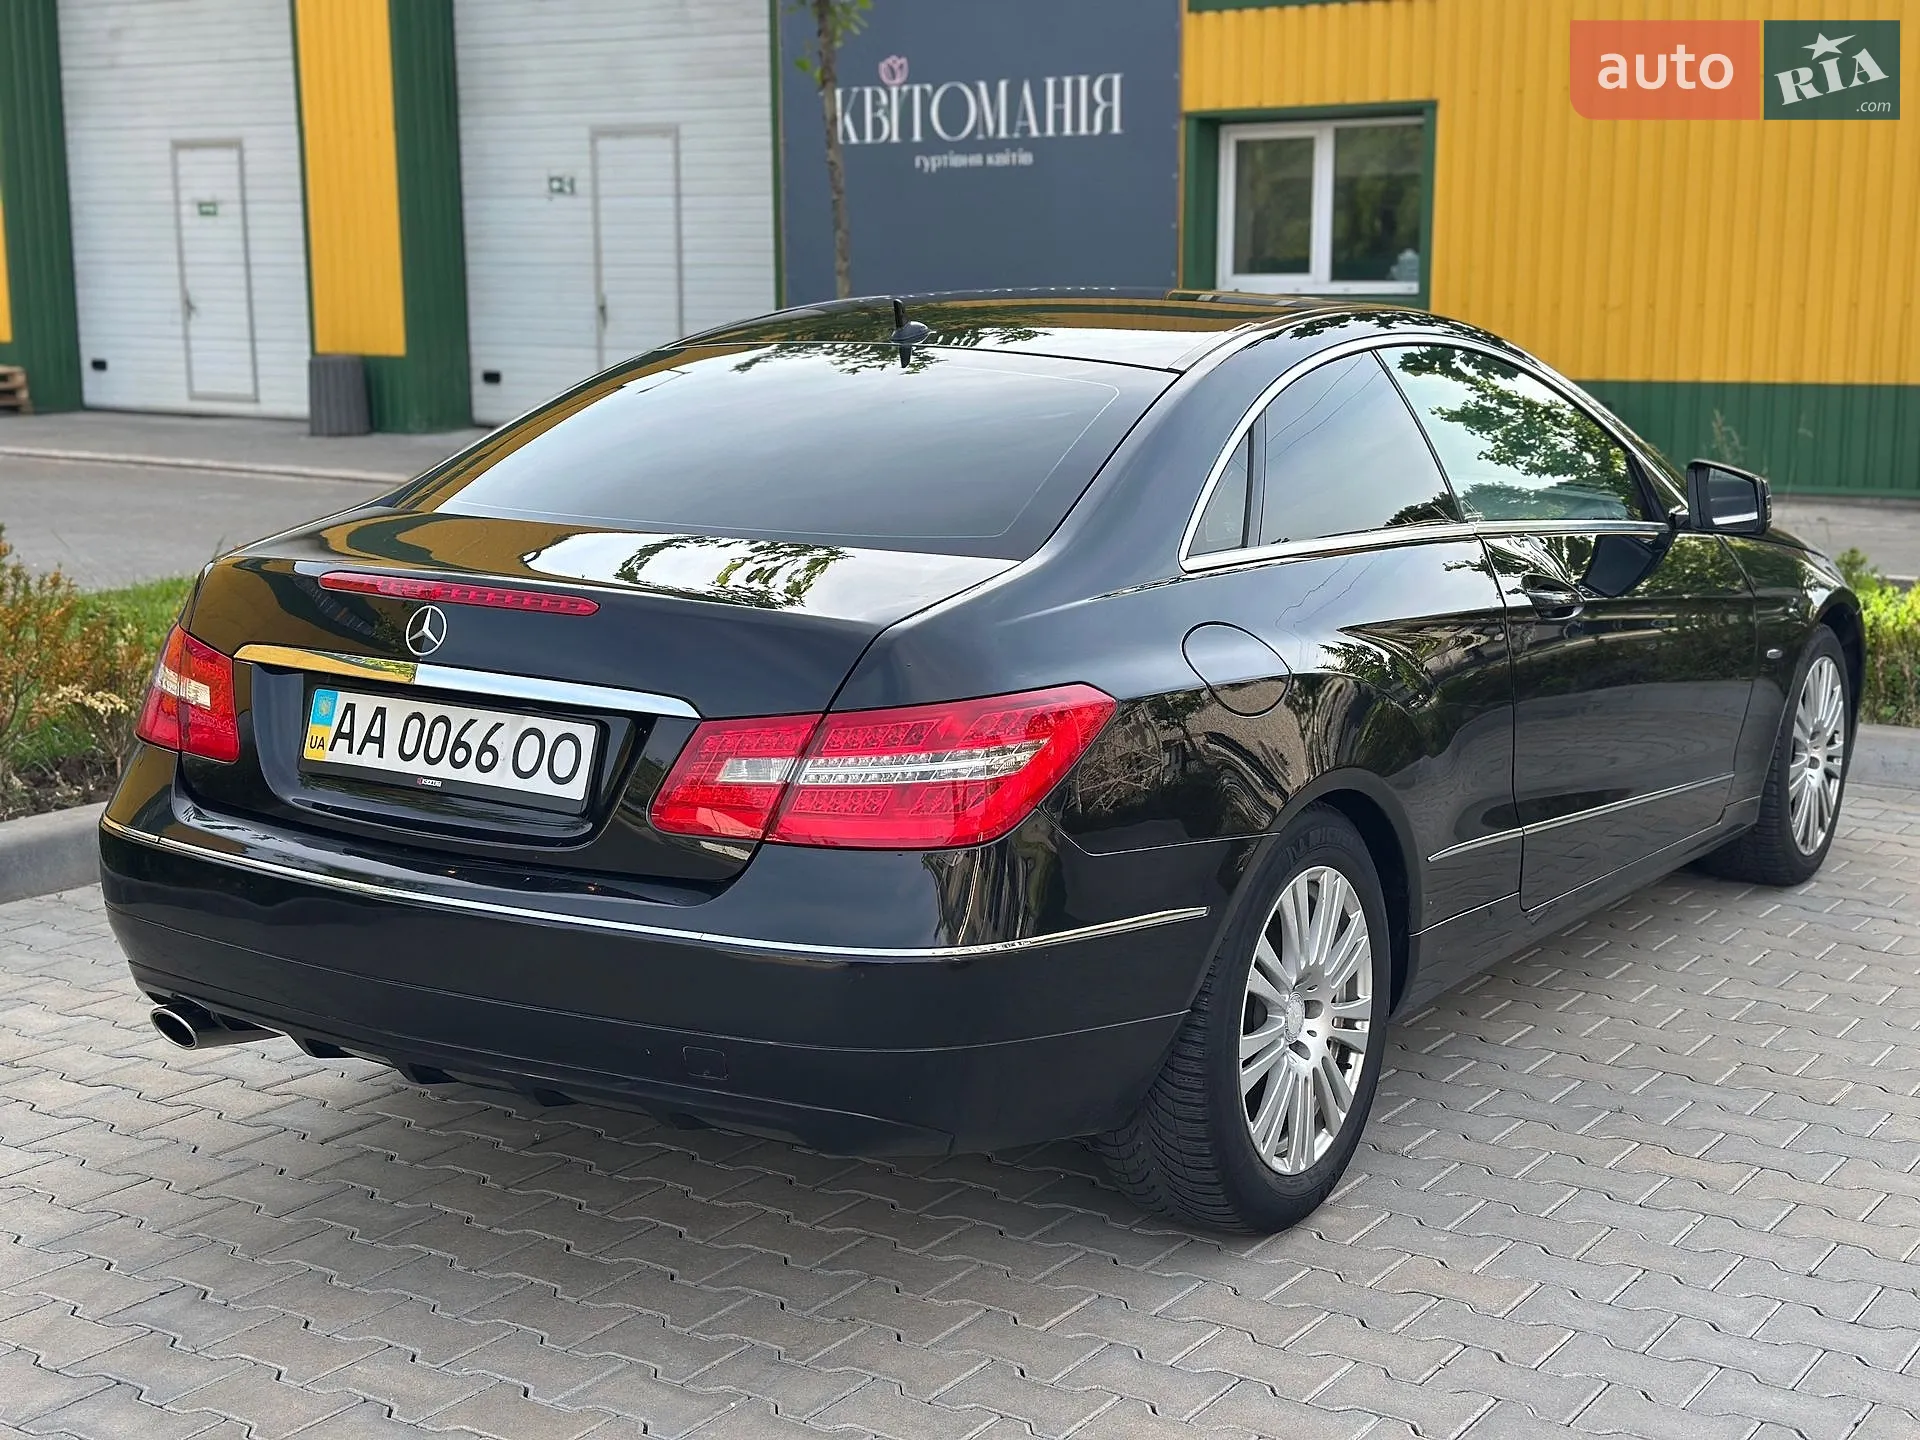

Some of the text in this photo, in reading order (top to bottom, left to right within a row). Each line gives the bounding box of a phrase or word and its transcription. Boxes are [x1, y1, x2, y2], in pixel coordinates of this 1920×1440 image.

[834, 72, 1125, 145] КВІТОМАНІЯ
[308, 734, 326, 751] UA
[328, 702, 388, 759] AA
[397, 711, 505, 774] 0066
